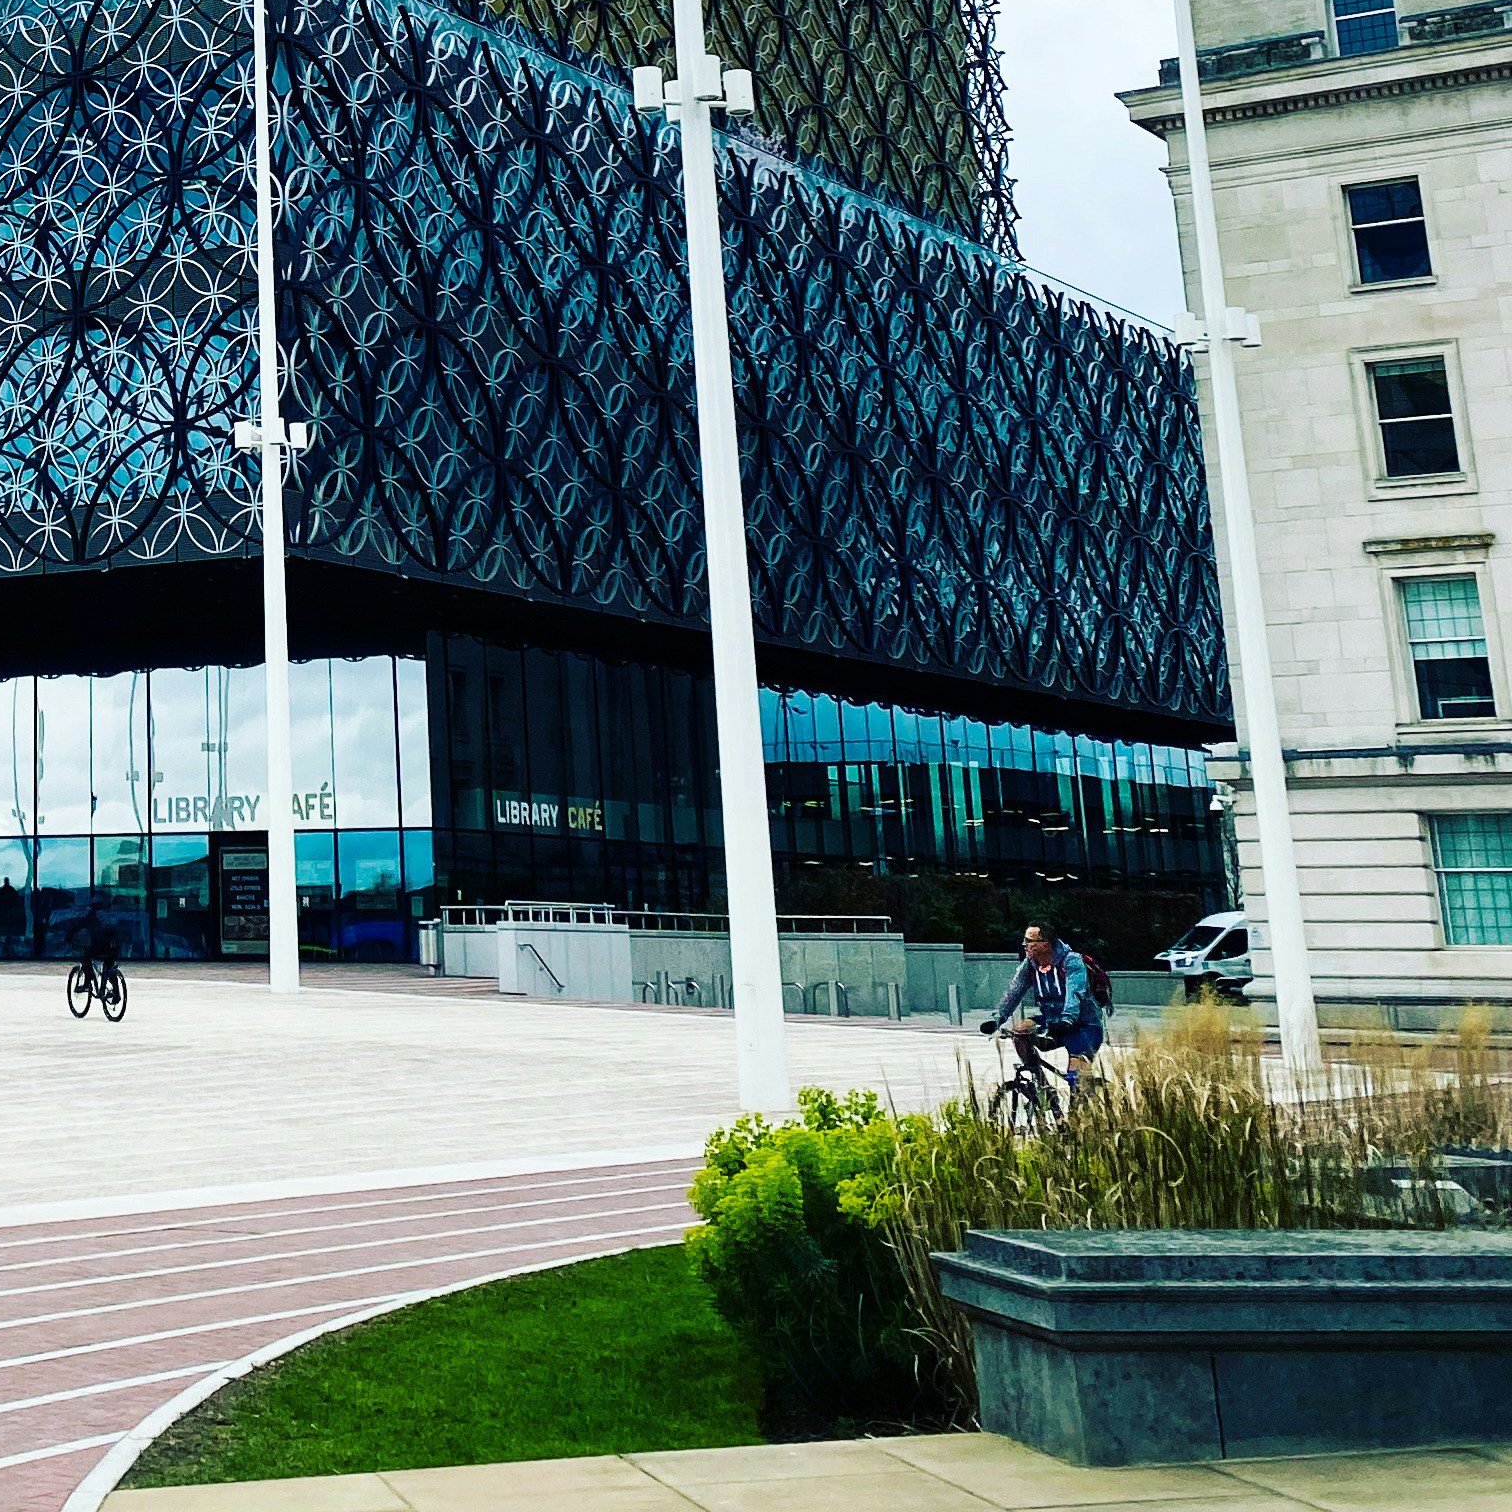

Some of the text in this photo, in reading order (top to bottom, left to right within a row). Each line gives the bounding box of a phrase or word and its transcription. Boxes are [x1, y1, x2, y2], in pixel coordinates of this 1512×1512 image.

[153, 781, 333, 824] LIBRARY AFÉ
[496, 799, 603, 831] LIBRARY CAFÉ
